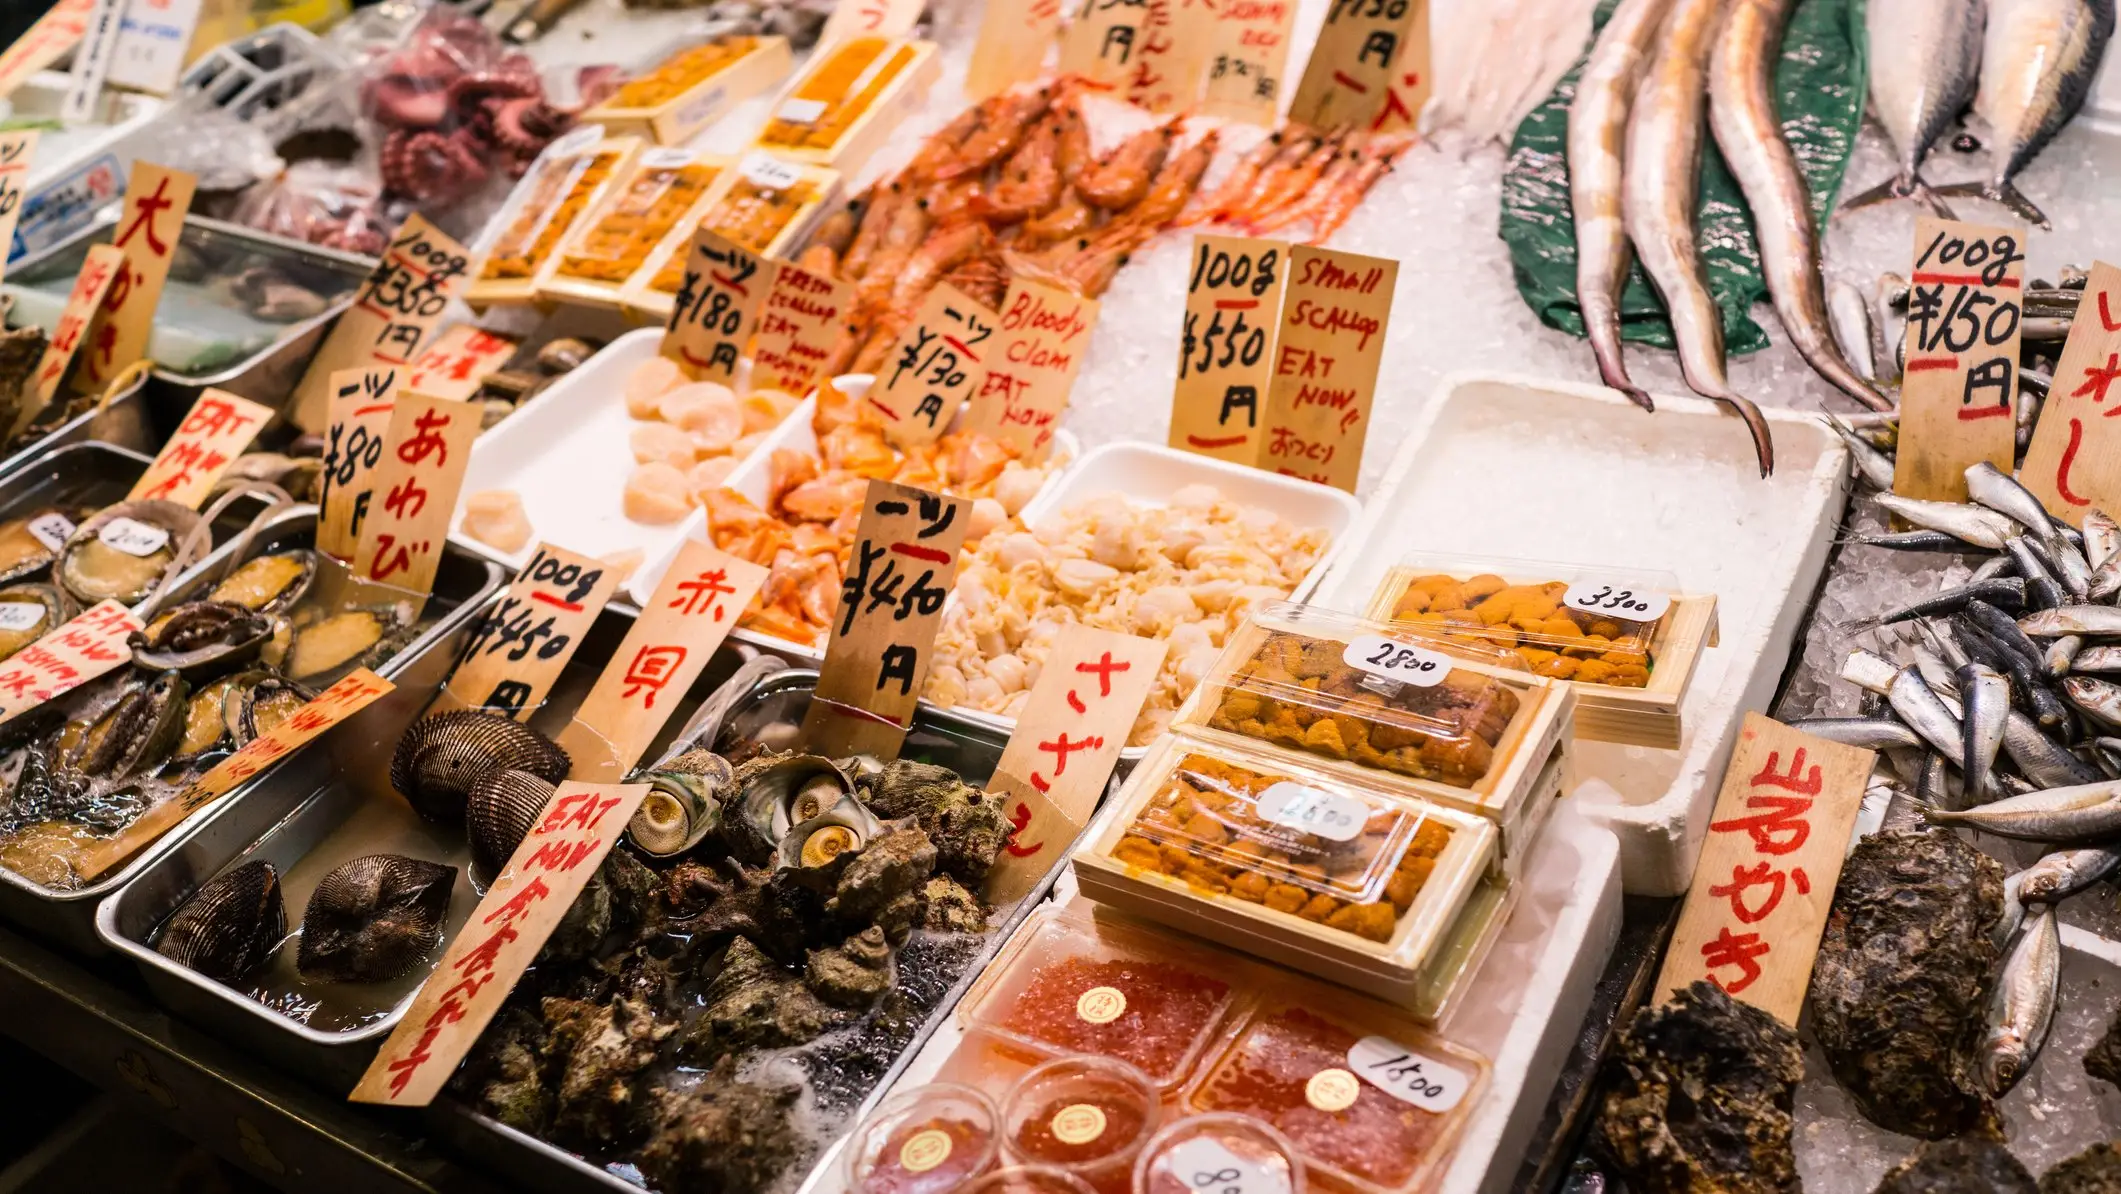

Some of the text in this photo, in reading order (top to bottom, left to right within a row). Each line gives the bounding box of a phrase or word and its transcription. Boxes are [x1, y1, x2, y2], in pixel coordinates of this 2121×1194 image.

[1189, 243, 1278, 297] 100g
[1915, 231, 2025, 287] 100g
[669, 271, 742, 334] ¥180
[1001, 290, 1087, 343] Bloody
[1908, 283, 2021, 353] ¥150
[888, 326, 967, 390] ¥130
[1007, 338, 1072, 373] Clam
[1179, 310, 1265, 380] ¥550
[1276, 344, 1335, 379] EAT
[979, 371, 1032, 401] EAT
[1218, 385, 1257, 427] 円
[1963, 357, 2013, 407] 円
[319, 422, 383, 523] ¥80
[369, 407, 451, 581] あわび
[517, 550, 604, 605] 100g
[841, 539, 948, 637] ¥450
[1577, 585, 1649, 612] 3300
[465, 597, 570, 664] ¥450
[621, 567, 737, 710] 赤貝
[1365, 643, 1437, 672] 2800
[876, 643, 918, 696] 円
[1004, 650, 1132, 858] さざえ
[534, 792, 623, 835] EAT
[522, 839, 602, 873] NOW
[1367, 1053, 1445, 1099] 1800
